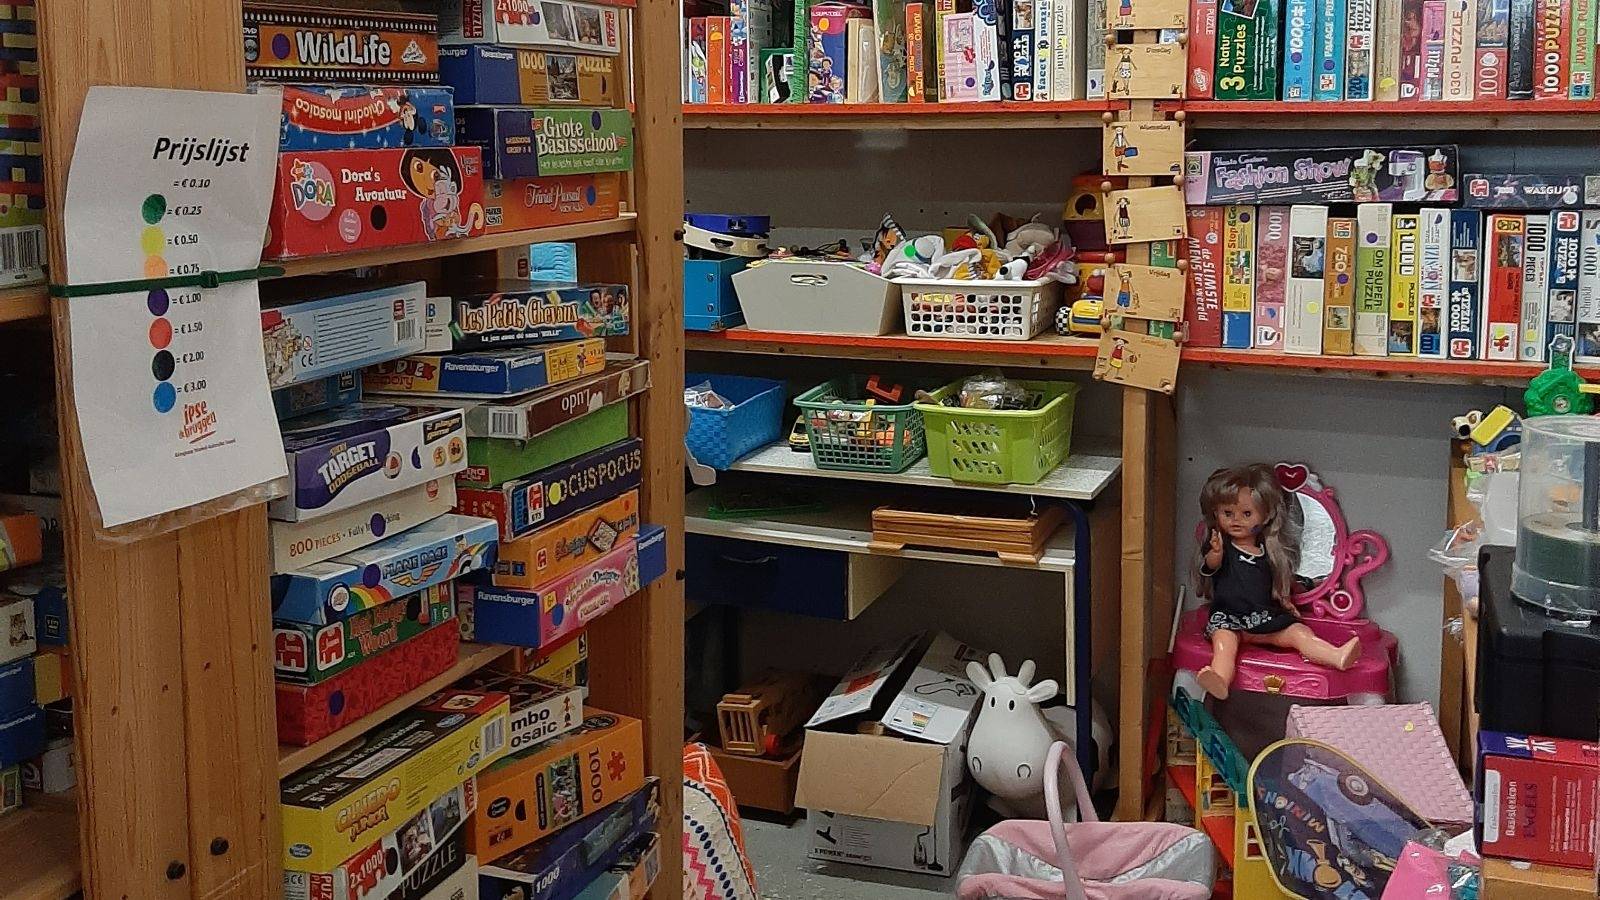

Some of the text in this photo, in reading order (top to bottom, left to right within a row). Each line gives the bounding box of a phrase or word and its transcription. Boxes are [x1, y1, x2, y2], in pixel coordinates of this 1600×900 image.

[1056, 5, 1066, 36] puzzle
[1206, 8, 1214, 35] PUZZLE
[295, 31, 391, 68] WildLife
[519, 51, 545, 70] 1000
[1219, 34, 1231, 67] Natur
[1233, 23, 1247, 74] Puzzles
[1450, 11, 1464, 96] 630 PUZZLE
[1576, 28, 1587, 65] JUMBO
[577, 56, 612, 73] PUZZLE
[1427, 49, 1441, 78] PUZZLE
[1479, 52, 1499, 97] 1000
[1544, 52, 1561, 94] 1000
[1220, 76, 1246, 91] 3
[295, 97, 385, 125] Chiodini mosaico
[543, 116, 584, 138] Grote
[153, 137, 249, 166] Prijslijst
[535, 132, 619, 157] Basisschool
[189, 179, 211, 188] 0.10
[341, 166, 382, 184] Dora's
[1215, 163, 1290, 190] Fashion
[1293, 157, 1352, 183] Show
[290, 176, 336, 211] DORA
[354, 186, 408, 202] Avontuur
[182, 206, 202, 215] 0.25
[181, 234, 199, 244] 0.50
[1268, 211, 1282, 240] 1000
[1336, 222, 1351, 238] MB
[1527, 222, 1547, 253] 1000
[1335, 245, 1348, 273] 750
[1399, 233, 1416, 277] 1000
[1567, 237, 1578, 267] 1000
[183, 264, 200, 274] 0.75
[1188, 237, 1208, 322] MENS ter wereld
[1201, 248, 1218, 310] de SLIMSTE
[1525, 256, 1536, 283] PIECES
[186, 293, 202, 303] 1.00
[1363, 270, 1374, 310] PUZZLE
[1374, 270, 1384, 307] SUPER
[459, 297, 580, 332] Les Petits Chevaux
[1451, 303, 1461, 332] 1000
[1460, 287, 1471, 332] PUZZLE
[187, 321, 203, 333] 1.50
[188, 351, 205, 362] 2.00
[444, 362, 500, 374] Ravensburger
[190, 380, 207, 391] 3.00
[184, 400, 208, 425] ipse
[317, 441, 376, 486] TARGET
[599, 449, 642, 483] POCUS
[289, 538, 314, 557] 800
[315, 532, 341, 548] PIECES
[477, 591, 535, 606] Ravensburger
[588, 747, 603, 804] 1000
[350, 848, 385, 889] 2x1000
[402, 841, 456, 899] PUZZLE
[536, 866, 560, 894] 1000
